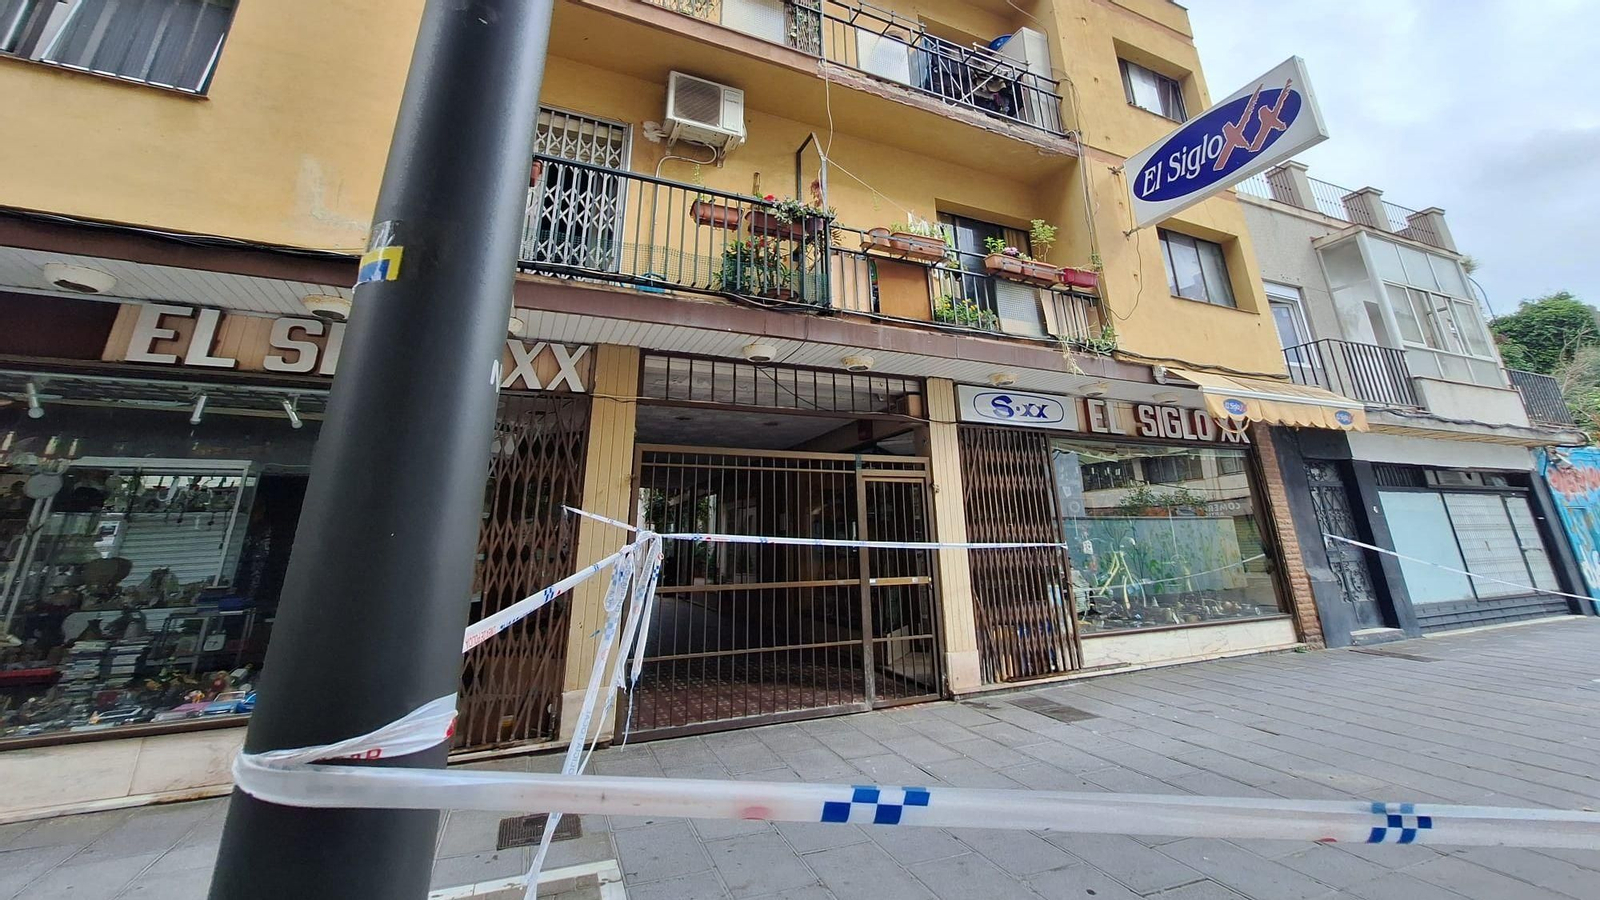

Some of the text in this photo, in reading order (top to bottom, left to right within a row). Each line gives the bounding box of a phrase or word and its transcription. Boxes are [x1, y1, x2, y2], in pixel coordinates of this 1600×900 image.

[1142, 161, 1163, 197] El
[1167, 133, 1223, 184] Siglo
[125, 303, 237, 368] EL
[500, 338, 591, 393] XX
[1087, 398, 1126, 435] EL
[1138, 404, 1213, 442] SIGLO
